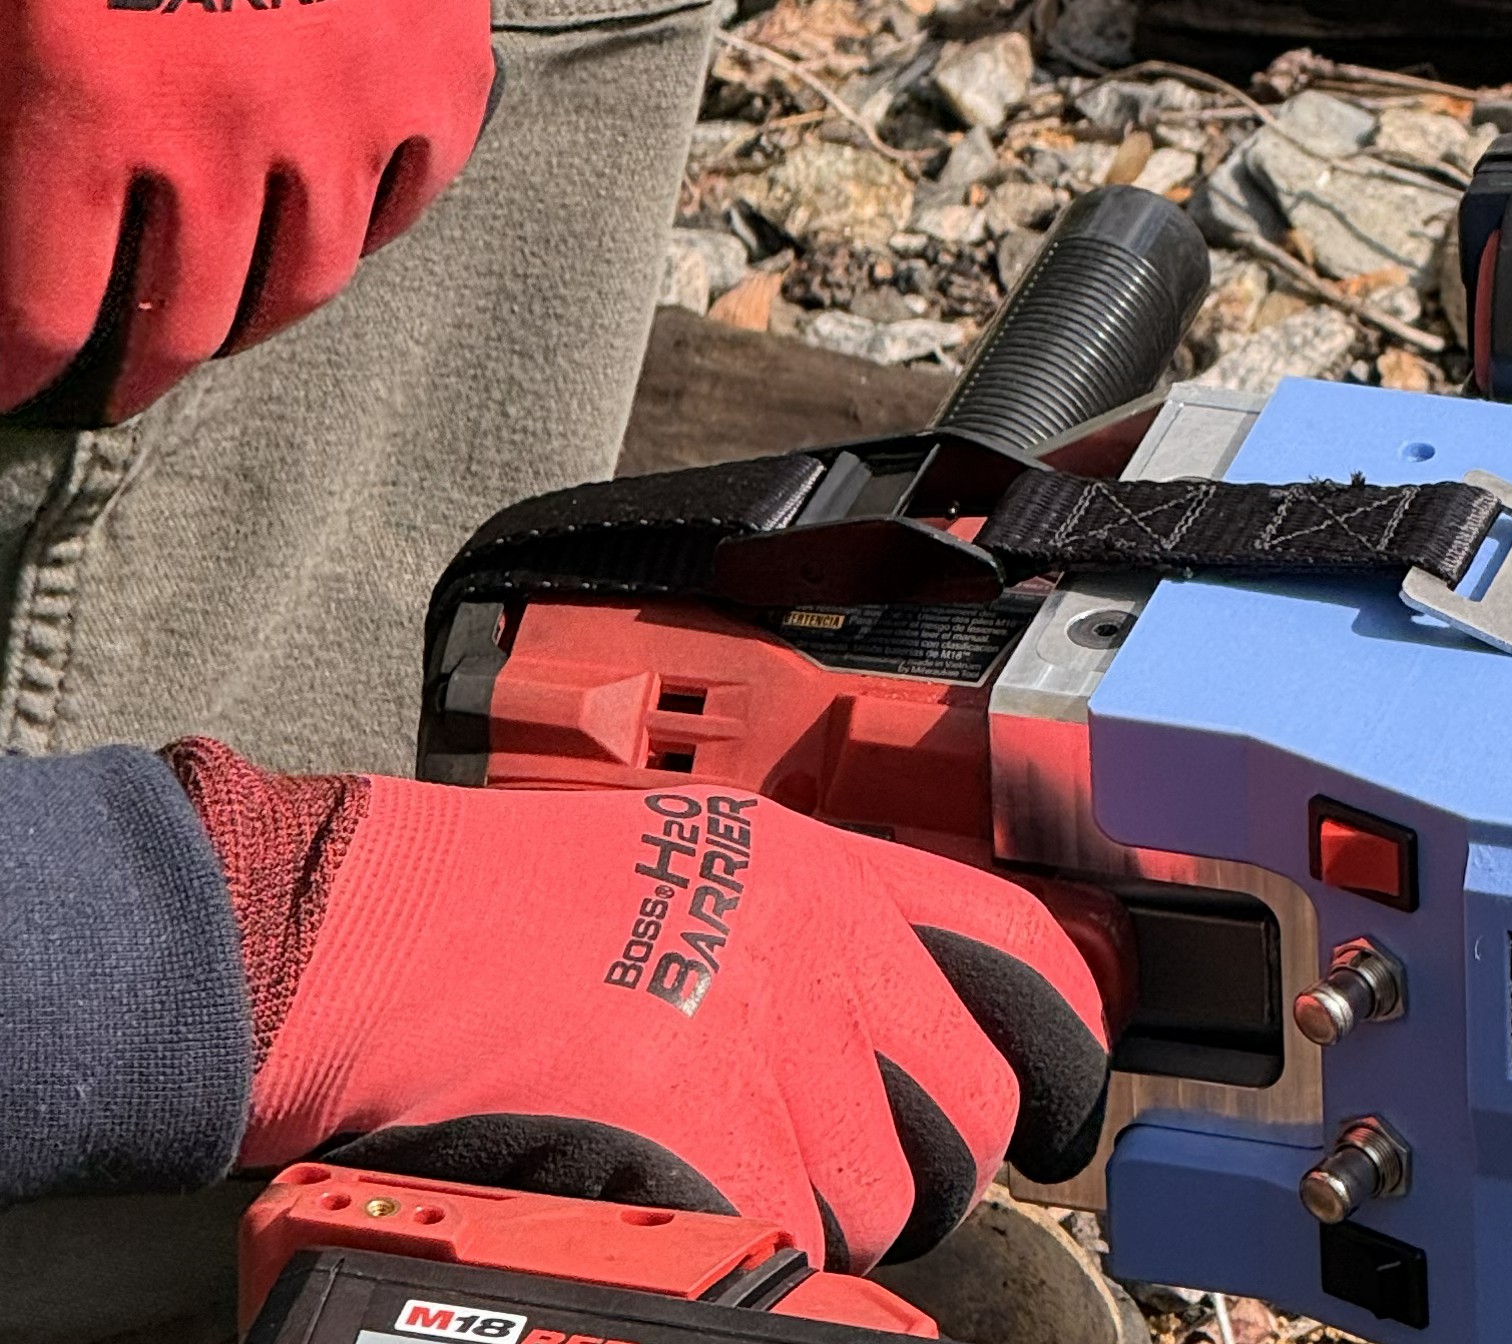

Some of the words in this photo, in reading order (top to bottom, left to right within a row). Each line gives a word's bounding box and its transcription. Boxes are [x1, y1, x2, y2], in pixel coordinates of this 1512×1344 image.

[635, 794, 703, 890] H2O
[646, 795, 759, 1019] BARRIER
[405, 1306, 517, 1339] M18
